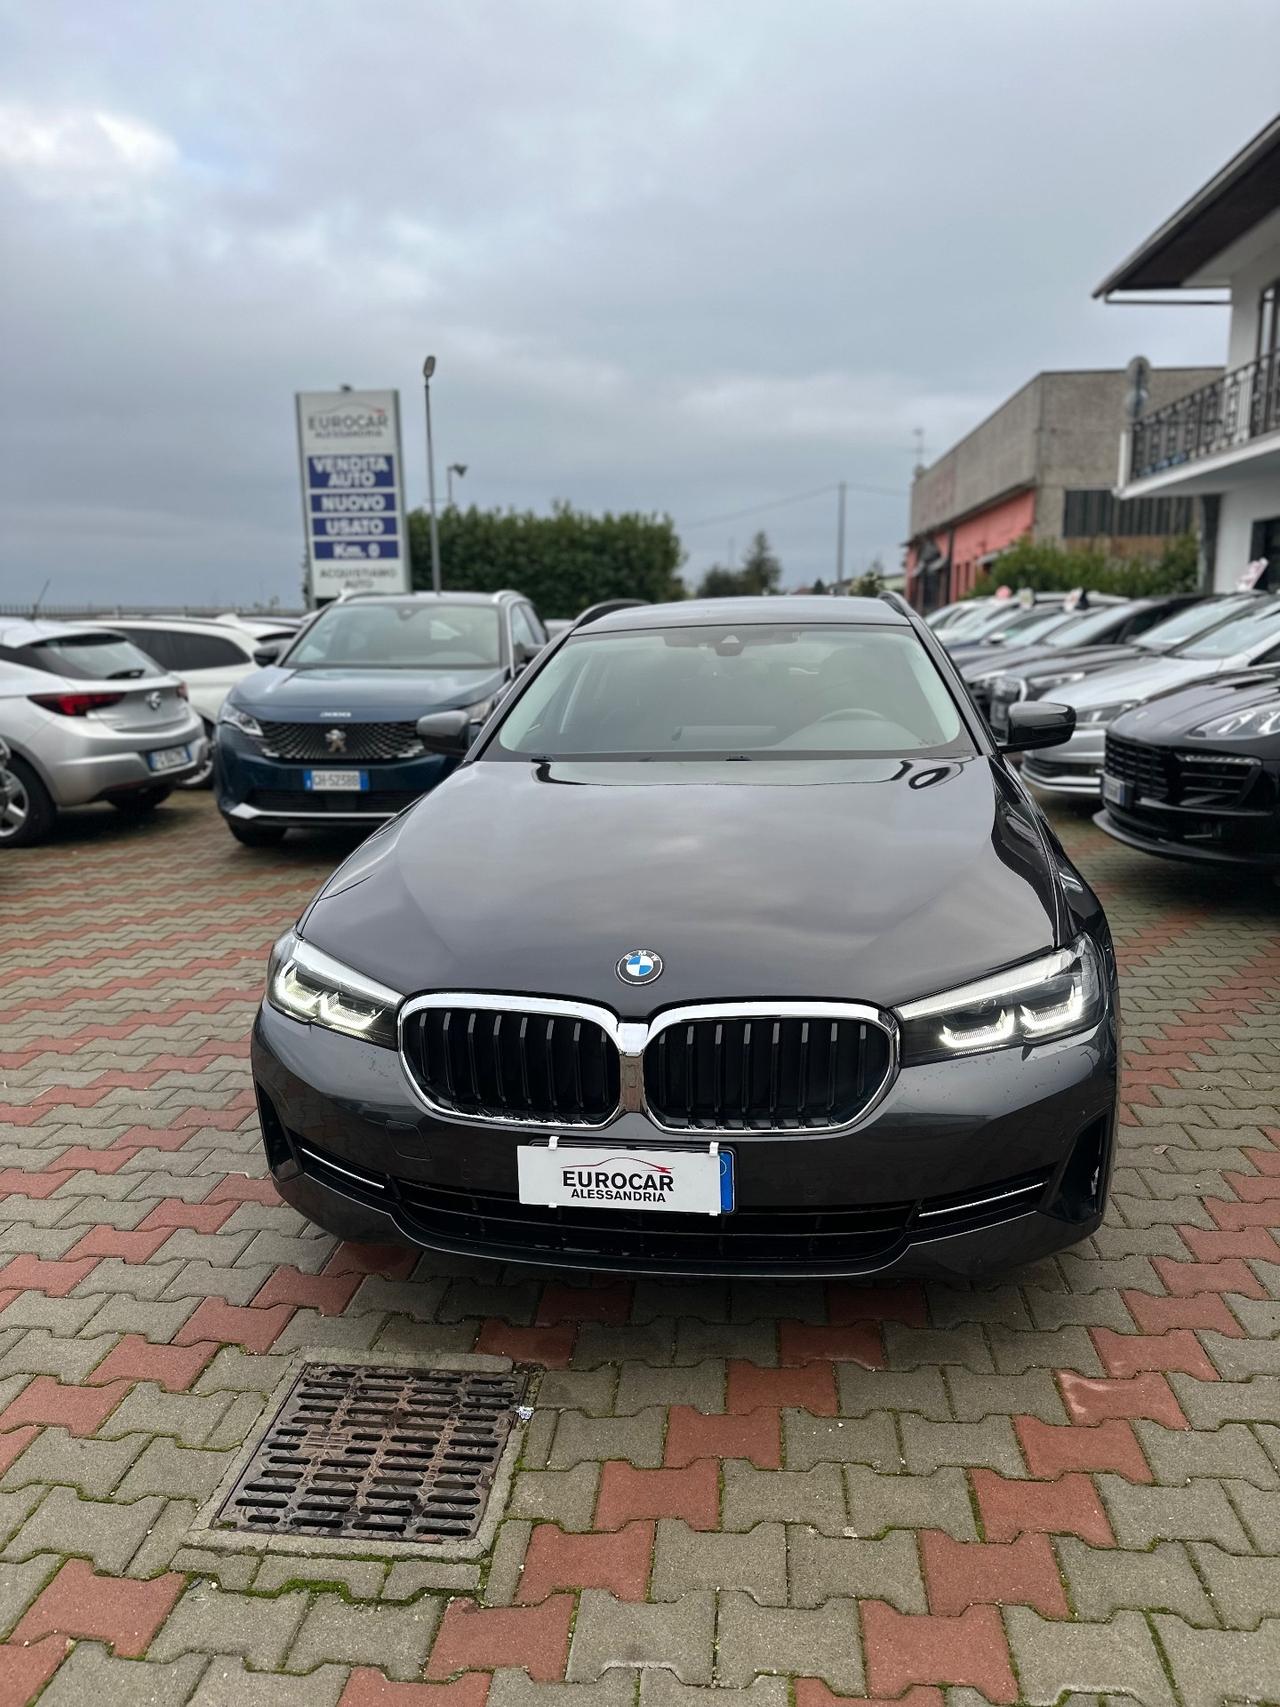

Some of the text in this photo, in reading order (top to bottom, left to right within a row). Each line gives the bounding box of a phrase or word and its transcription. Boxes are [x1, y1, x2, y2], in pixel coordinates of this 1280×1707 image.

[308, 413, 388, 431] EUROCAR
[312, 456, 389, 473] VENDITA
[328, 470, 376, 488] AUTO
[321, 494, 386, 512] NUOVO
[325, 517, 384, 536] USATO
[333, 542, 380, 558] Km. 0
[344, 579, 375, 589] AUTO
[562, 1170, 675, 1192] EUROCAR
[571, 1188, 666, 1203] ALESSANDRIA
